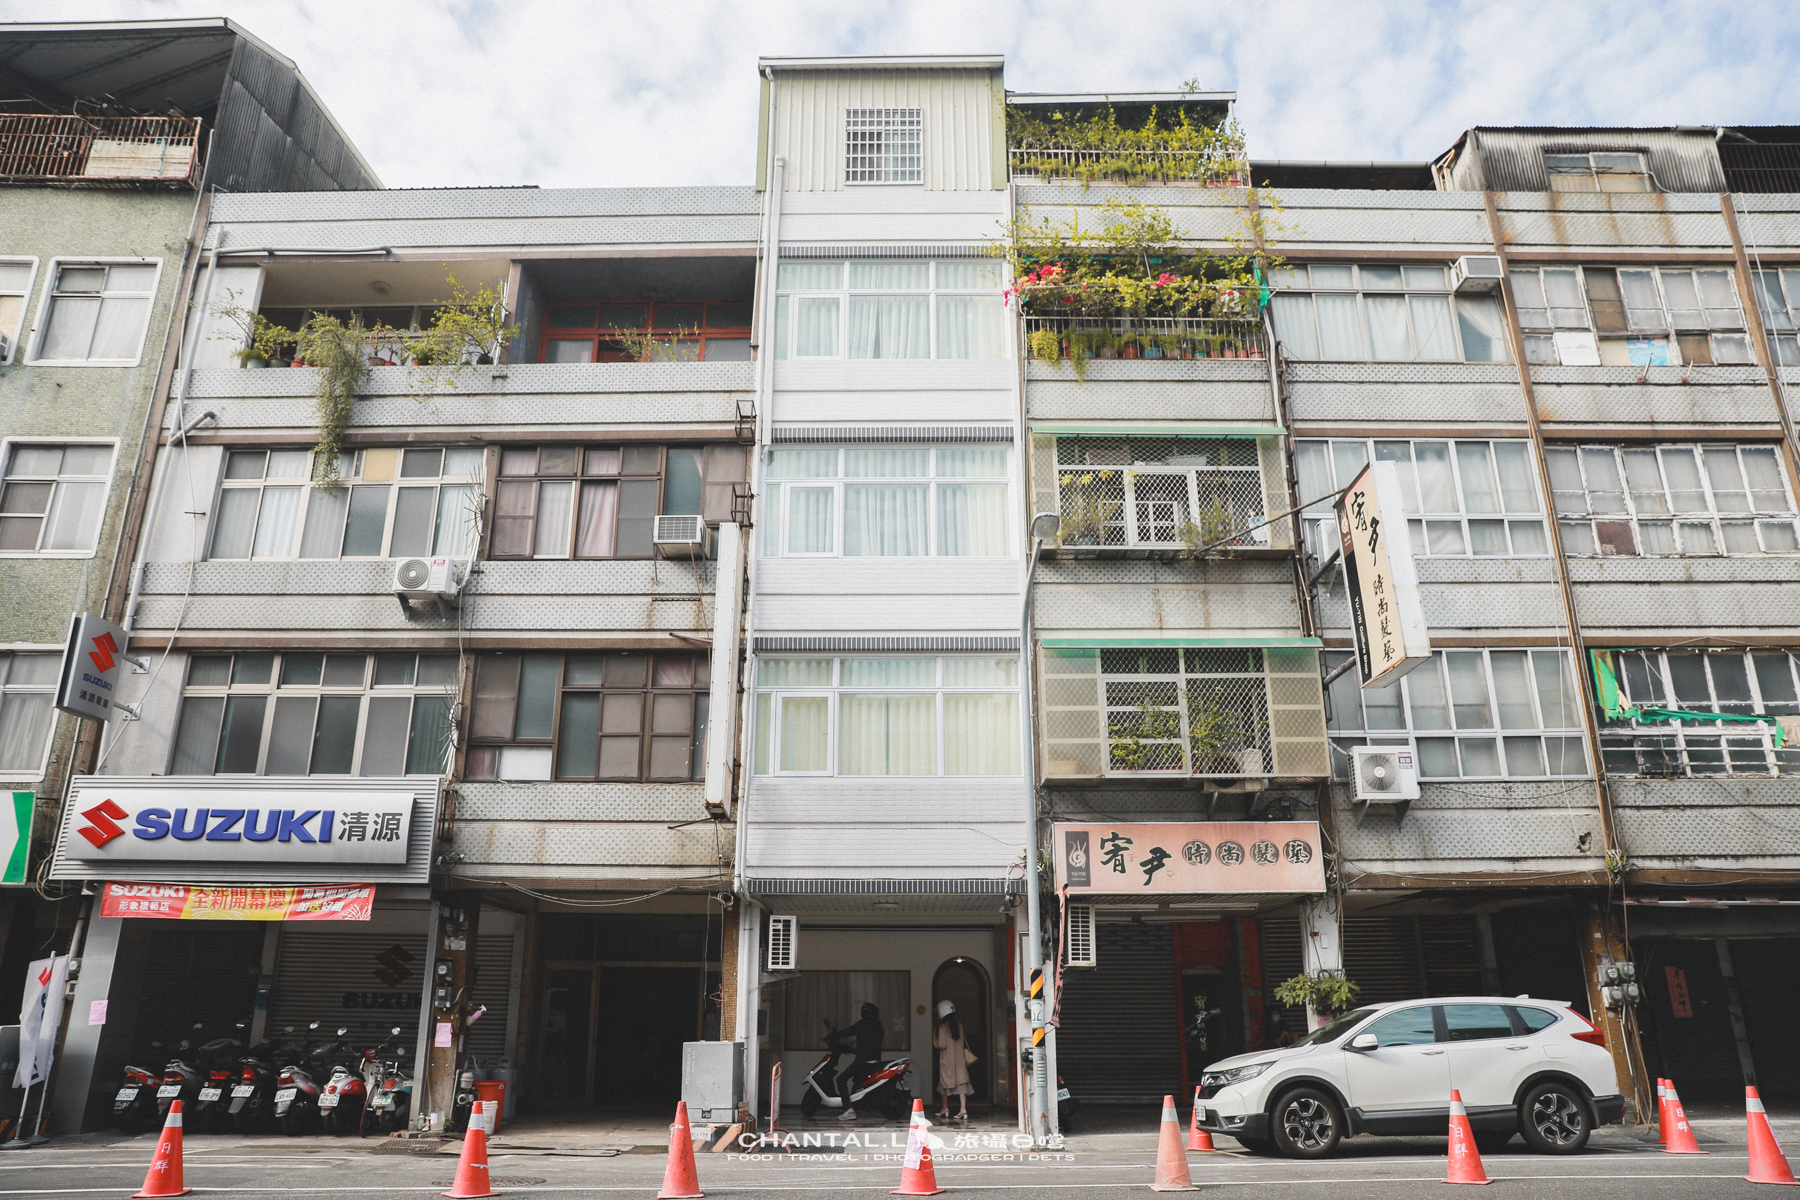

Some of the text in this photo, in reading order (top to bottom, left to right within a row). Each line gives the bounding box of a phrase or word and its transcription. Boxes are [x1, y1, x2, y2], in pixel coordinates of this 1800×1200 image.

[82, 673, 112, 692] SUZUKI
[132, 808, 403, 843] SUZUKI 清源
[1183, 840, 1311, 865] 時尚髮藝
[110, 884, 184, 898] SUZUKI
[191, 887, 286, 910] 全新開幕慶
[296, 901, 345, 912] 加送好禮
